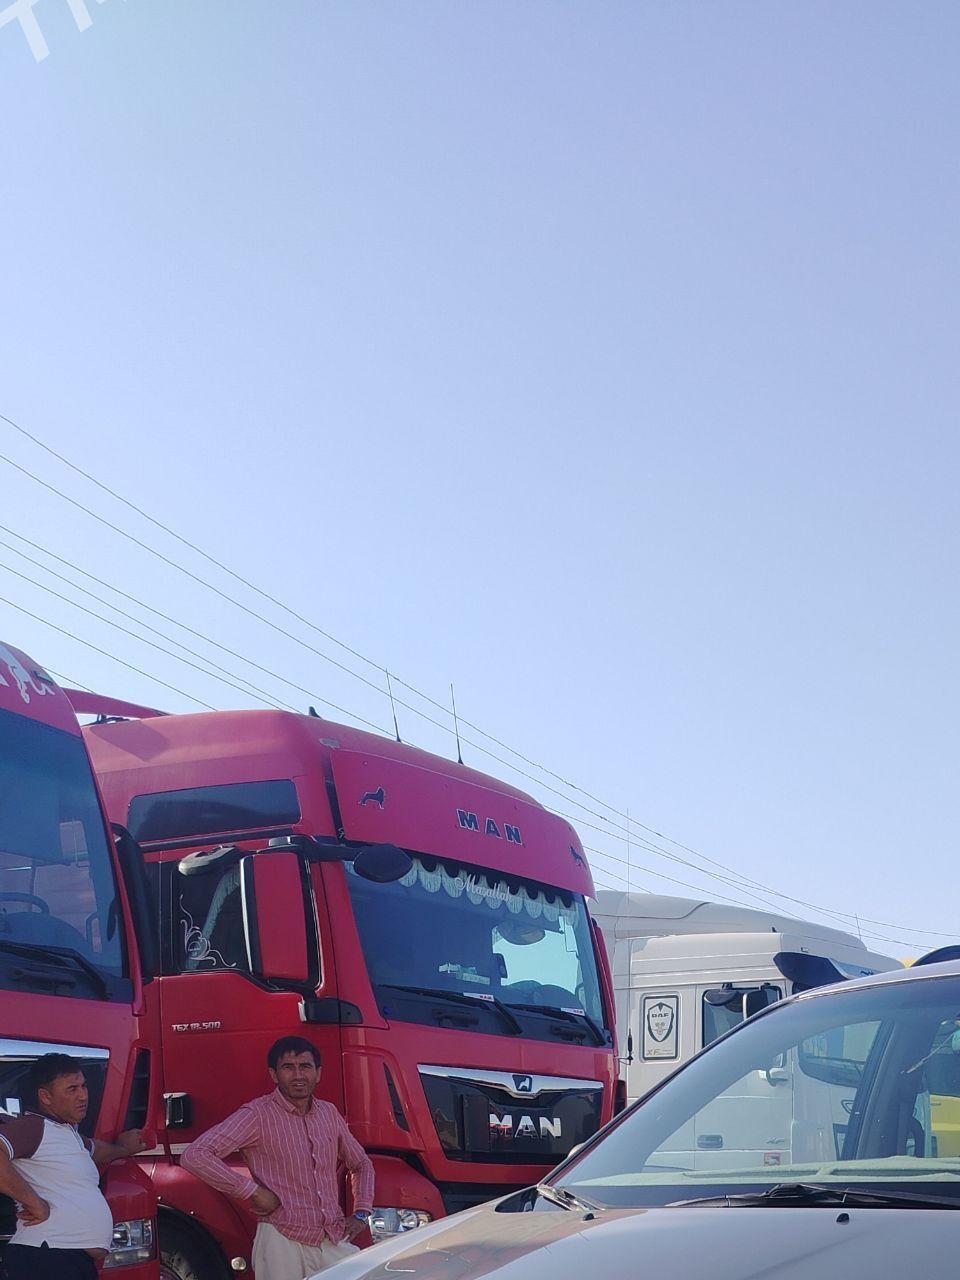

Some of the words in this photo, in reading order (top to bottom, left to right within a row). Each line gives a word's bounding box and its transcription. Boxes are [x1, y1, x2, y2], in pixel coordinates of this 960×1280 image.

[456, 809, 523, 845] MAN
[171, 1023, 189, 1031] TGX
[489, 1113, 562, 1138] MAN
